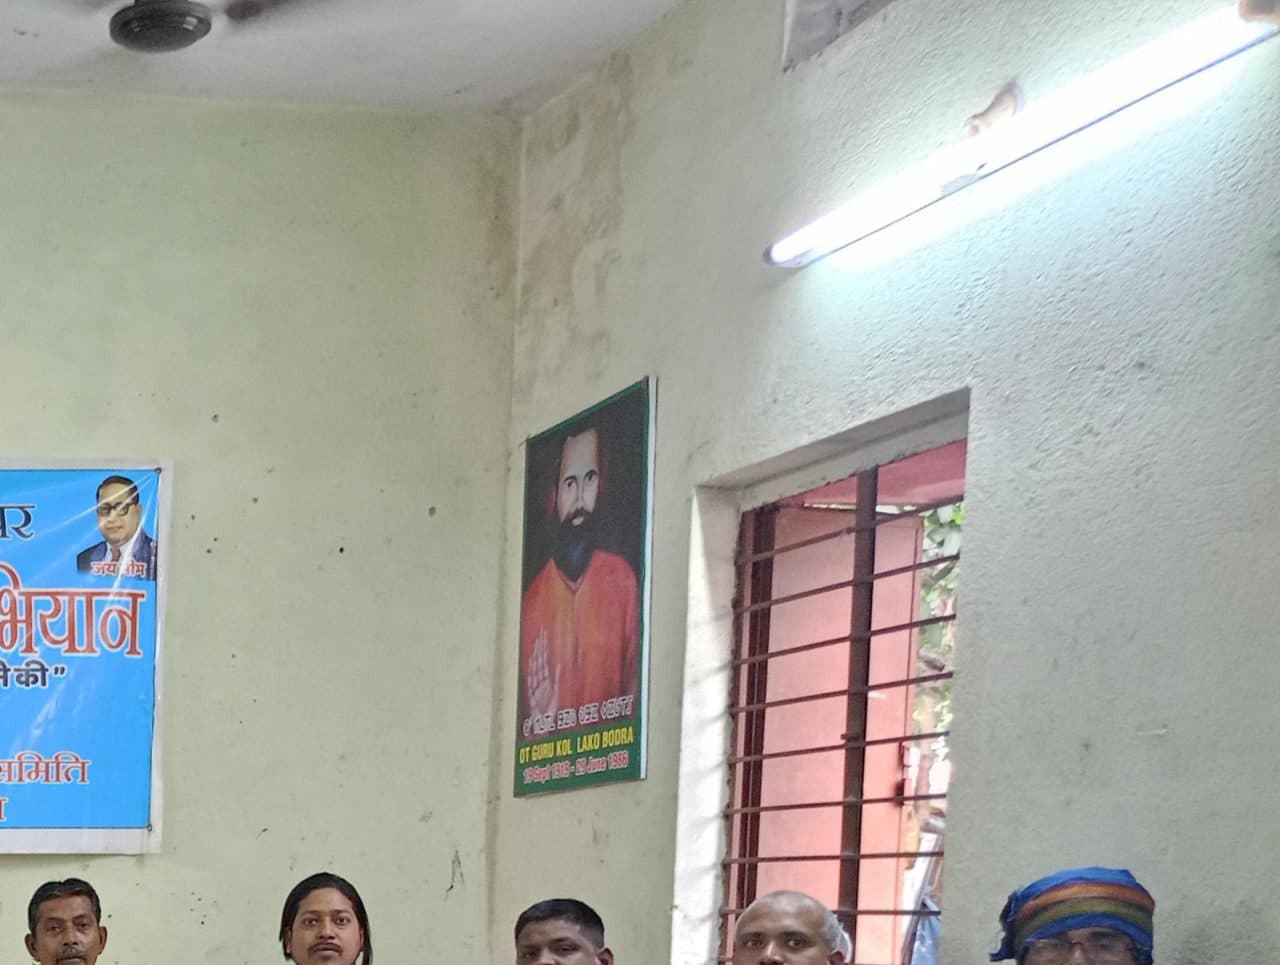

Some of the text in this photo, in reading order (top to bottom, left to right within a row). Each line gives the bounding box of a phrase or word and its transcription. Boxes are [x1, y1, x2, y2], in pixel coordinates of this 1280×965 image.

[92, 562, 118, 577] जय
[532, 741, 554, 760] GURU
[556, 738, 573, 756] KOL
[577, 732, 601, 752] LAKO
[602, 726, 633, 748] BODRA
